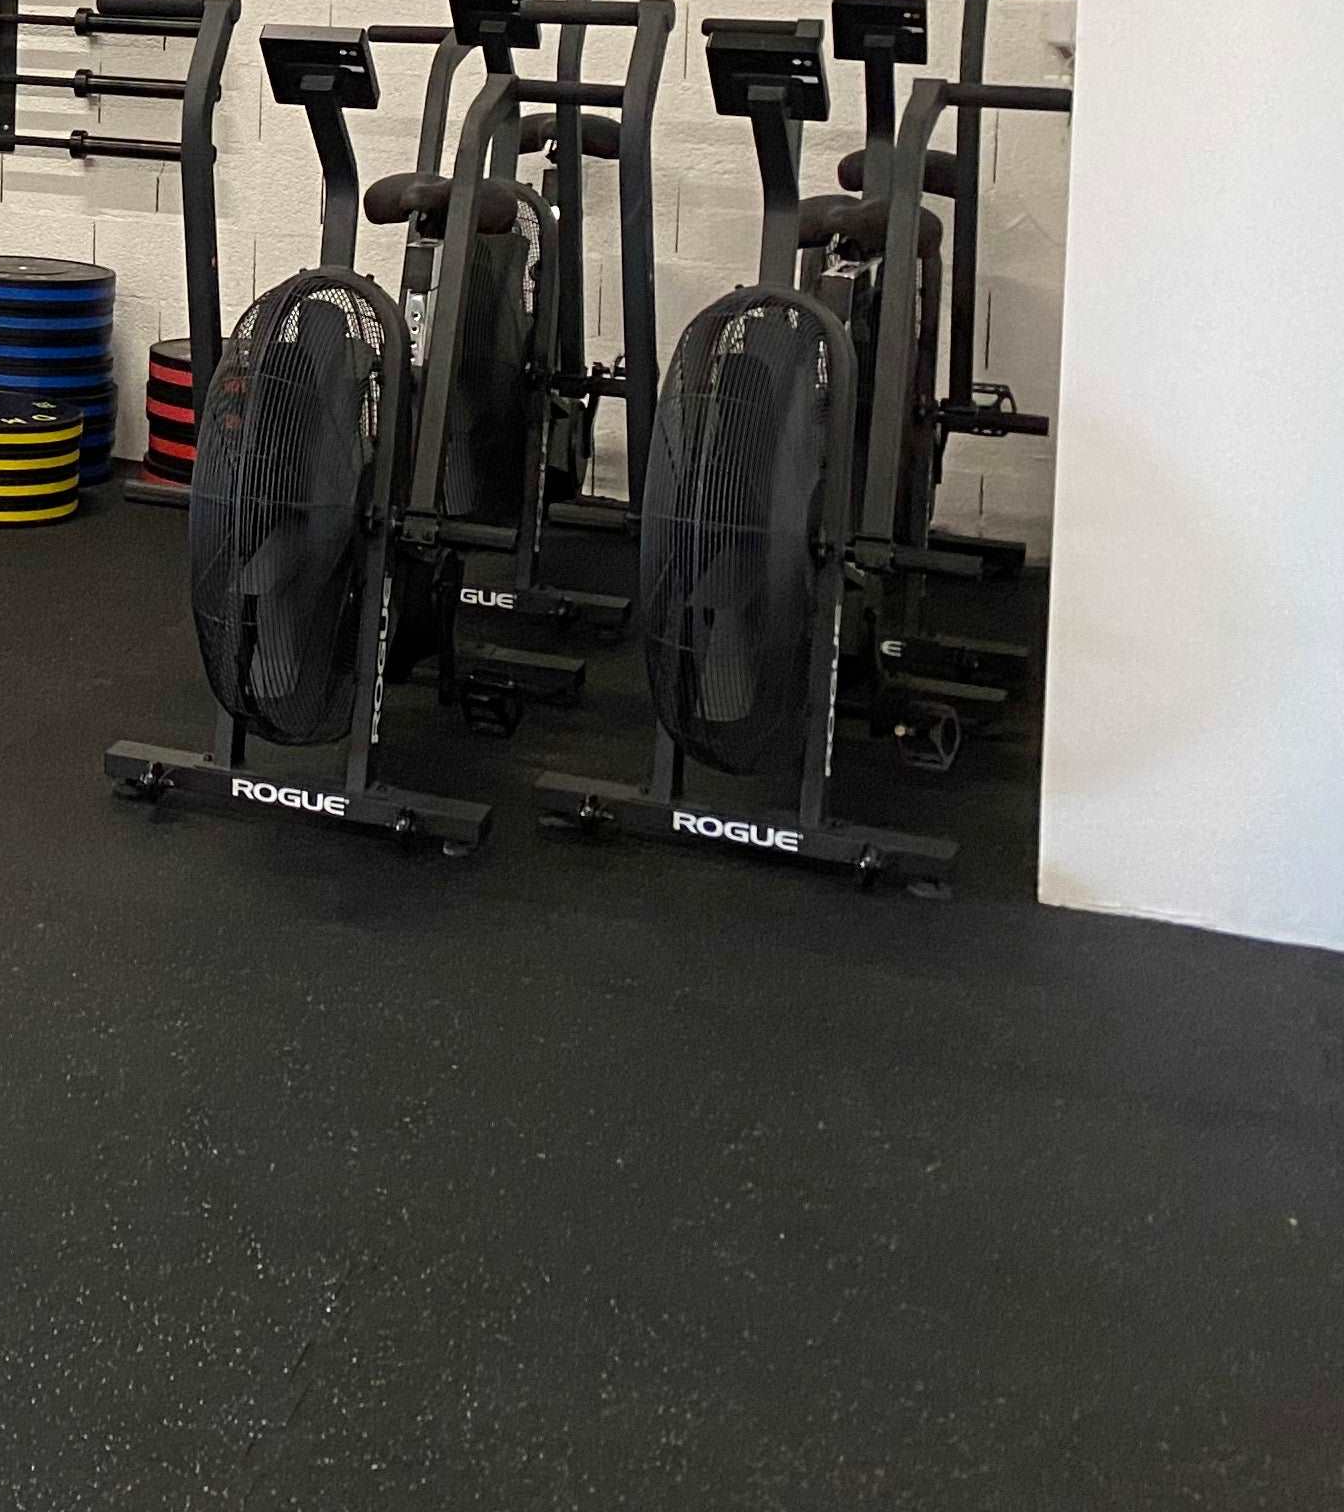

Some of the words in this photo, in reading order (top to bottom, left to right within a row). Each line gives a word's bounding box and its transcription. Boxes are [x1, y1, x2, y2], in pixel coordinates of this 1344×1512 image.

[460, 588, 515, 610] GUE
[371, 577, 393, 744] ROGUE
[231, 778, 346, 816] ROGUE
[673, 810, 800, 853] ROGUE
